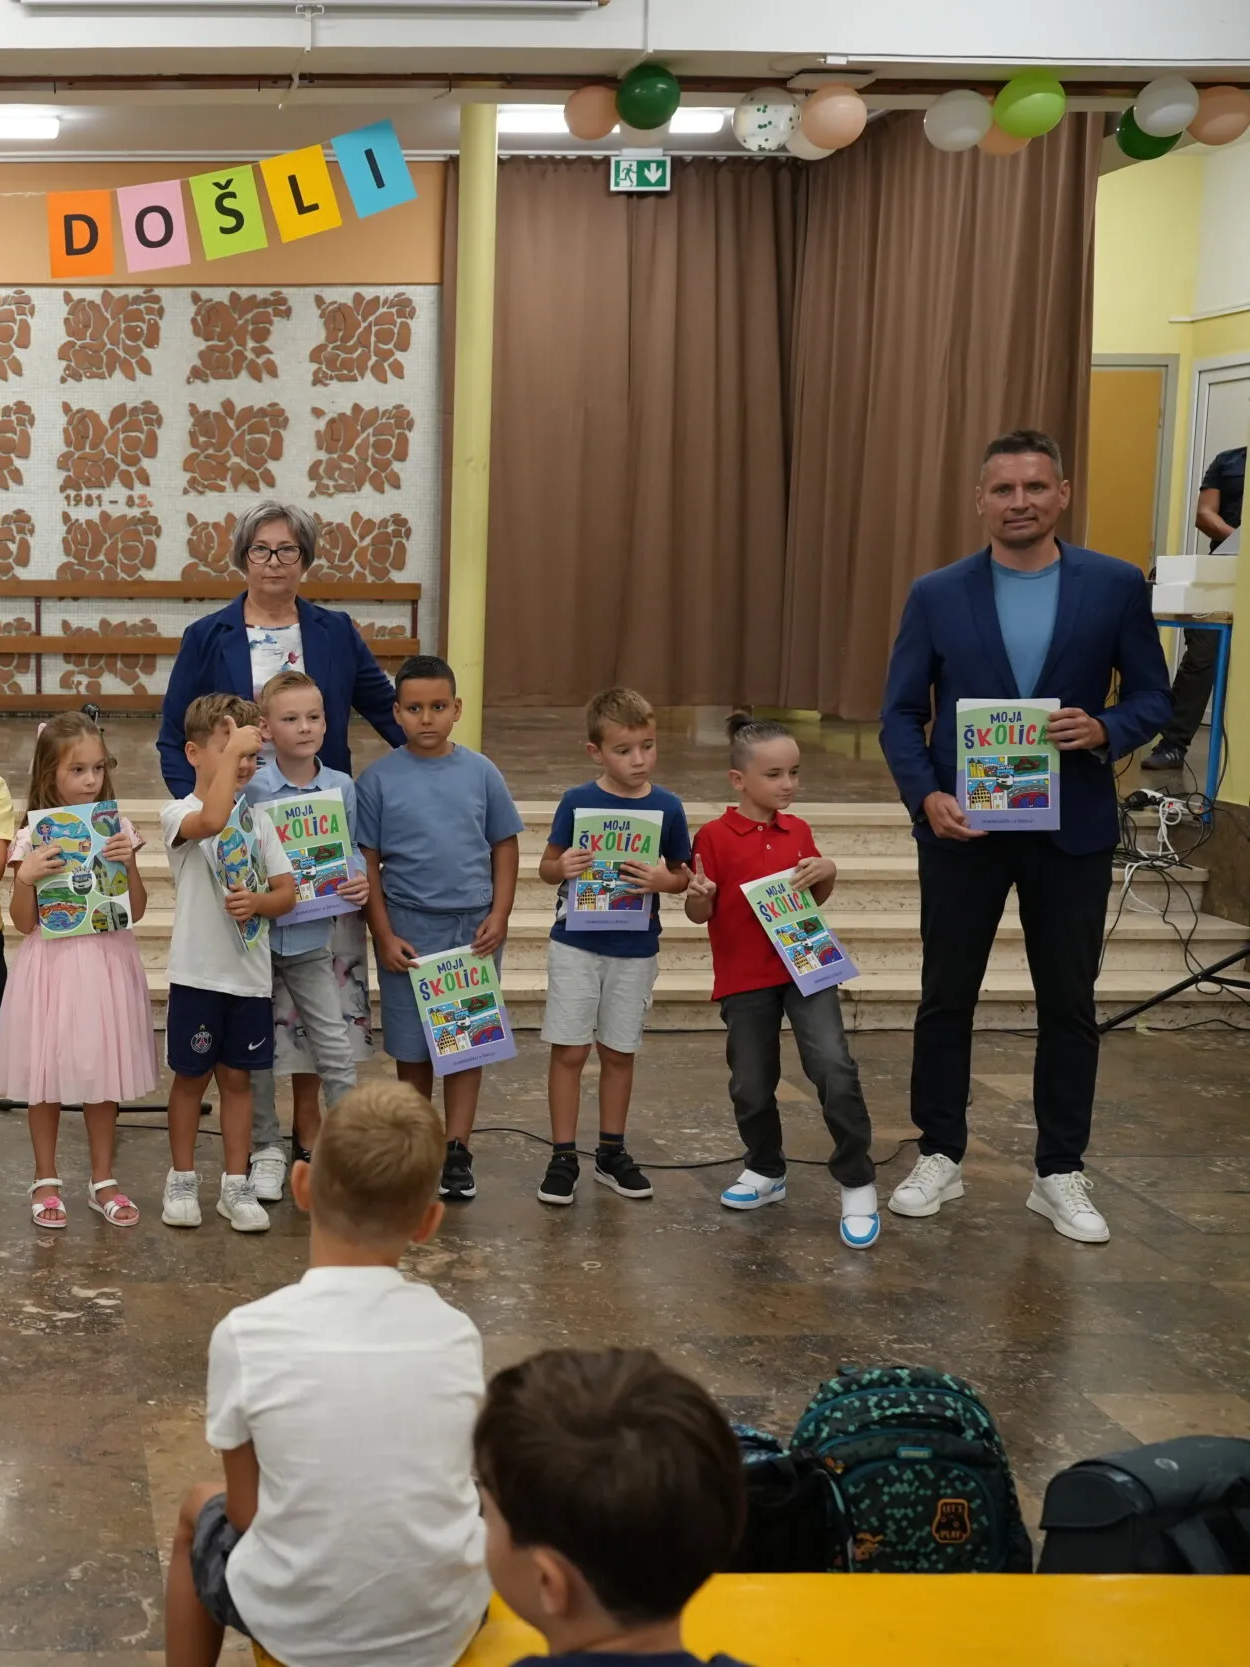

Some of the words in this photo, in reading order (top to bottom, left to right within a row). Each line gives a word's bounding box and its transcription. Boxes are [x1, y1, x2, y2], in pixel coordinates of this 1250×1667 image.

[62, 147, 386, 257] DOŠLI
[990, 711, 1022, 724] MOJA
[285, 804, 314, 820] MOJA
[603, 820, 631, 831] MOJA
[765, 882, 787, 898] MOJA
[436, 957, 464, 974] MOJA
